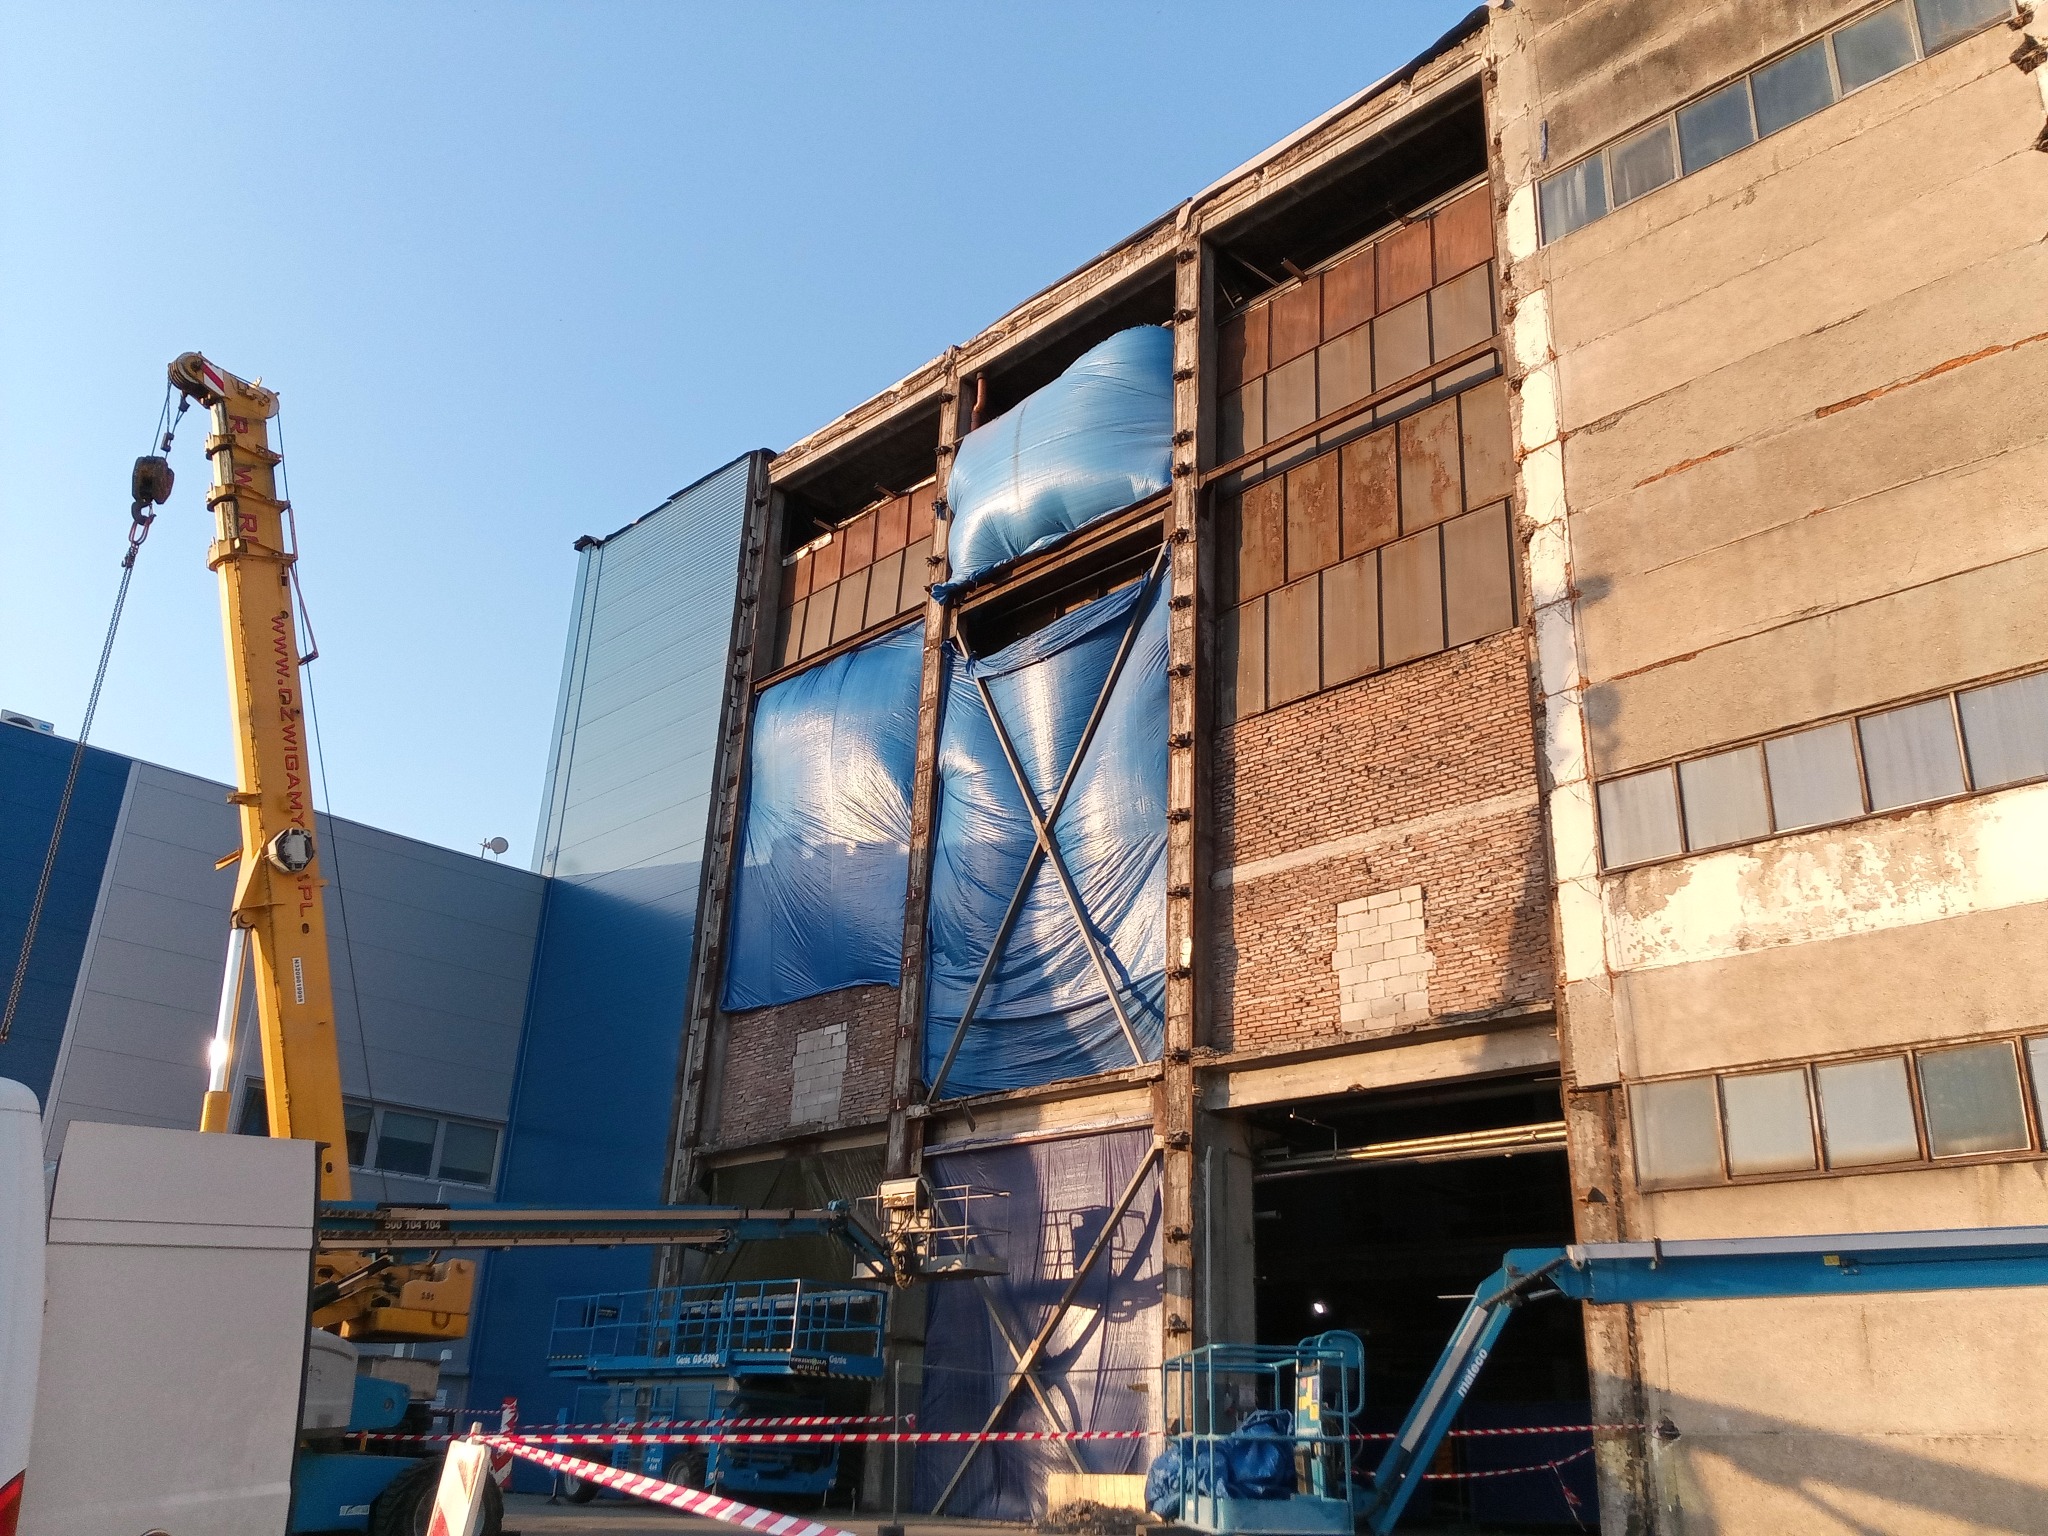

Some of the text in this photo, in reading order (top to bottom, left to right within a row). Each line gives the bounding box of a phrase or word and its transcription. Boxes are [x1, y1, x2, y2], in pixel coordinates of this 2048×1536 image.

[229, 415, 248, 434] R
[405, 1220, 421, 1230] 104
[424, 1220, 441, 1230] 104
